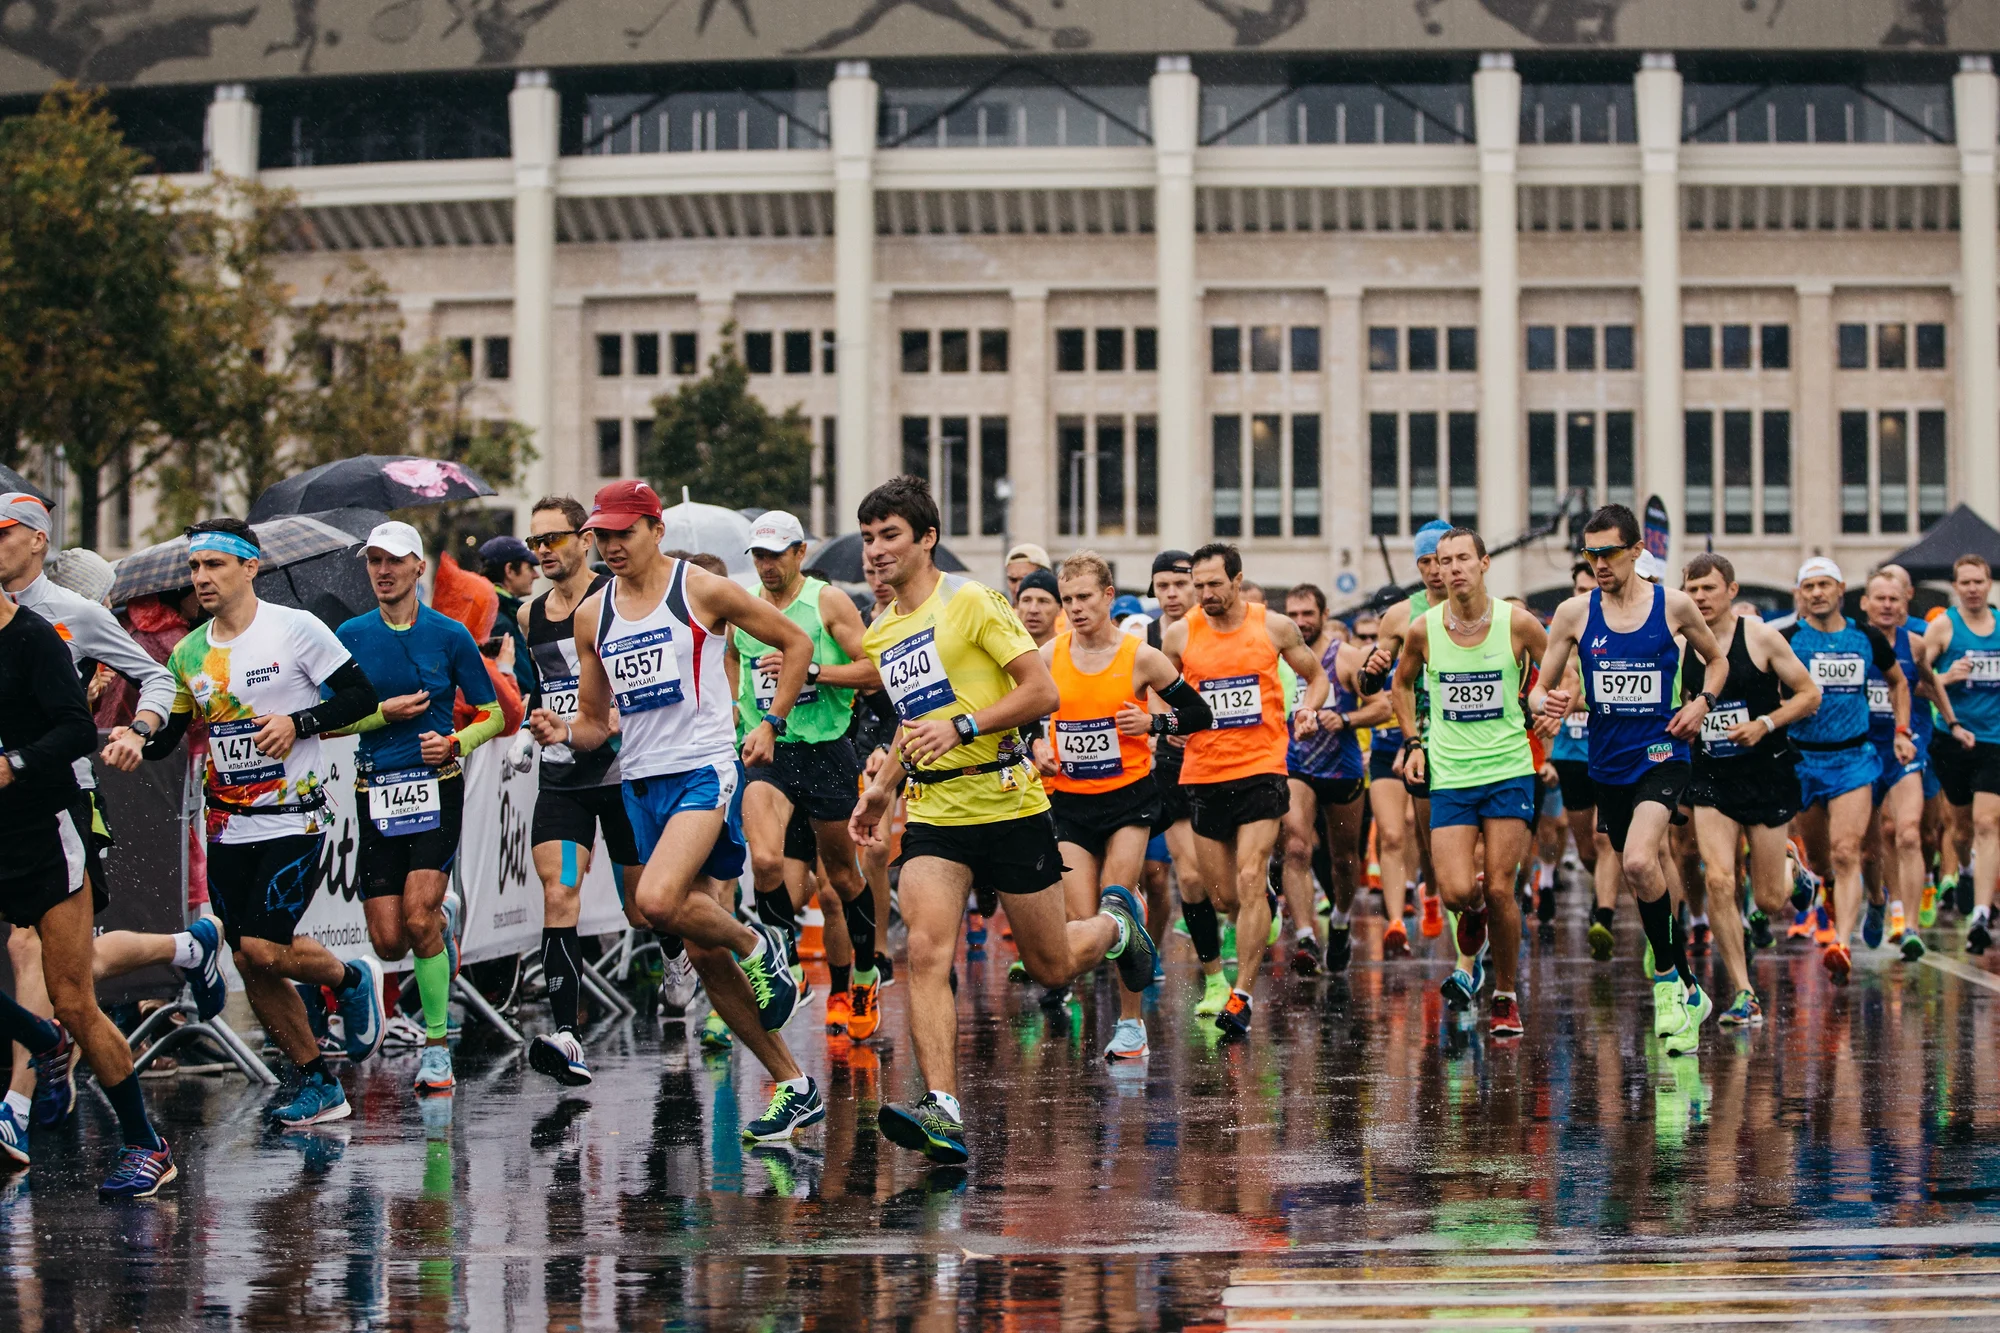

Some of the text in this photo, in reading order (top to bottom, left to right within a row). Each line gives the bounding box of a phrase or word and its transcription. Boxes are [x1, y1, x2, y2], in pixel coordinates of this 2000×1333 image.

[614, 648, 663, 681] 4557
[890, 650, 930, 688] 4340
[1818, 662, 1857, 678] 5009
[246, 675, 270, 687] grom
[628, 676, 656, 689] МИХАИЛ
[903, 680, 920, 692] ЮРИЙ
[1602, 674, 1652, 694] 5970
[1448, 684, 1494, 703] 2839
[622, 694, 630, 706] B
[764, 698, 772, 709] B
[1210, 690, 1254, 710] 1132
[898, 701, 906, 716] B
[1603, 704, 1611, 714] B
[1450, 712, 1457, 720] B
[1064, 734, 1110, 754] 4323
[1650, 744, 1670, 754] TAG
[228, 760, 262, 770] ИЛЬГИЗАР
[1066, 762, 1074, 772] B
[224, 773, 232, 785] B
[380, 784, 429, 808] 1445
[390, 804, 420, 816] АЛЕКСЕЙ
[380, 818, 389, 830] B
